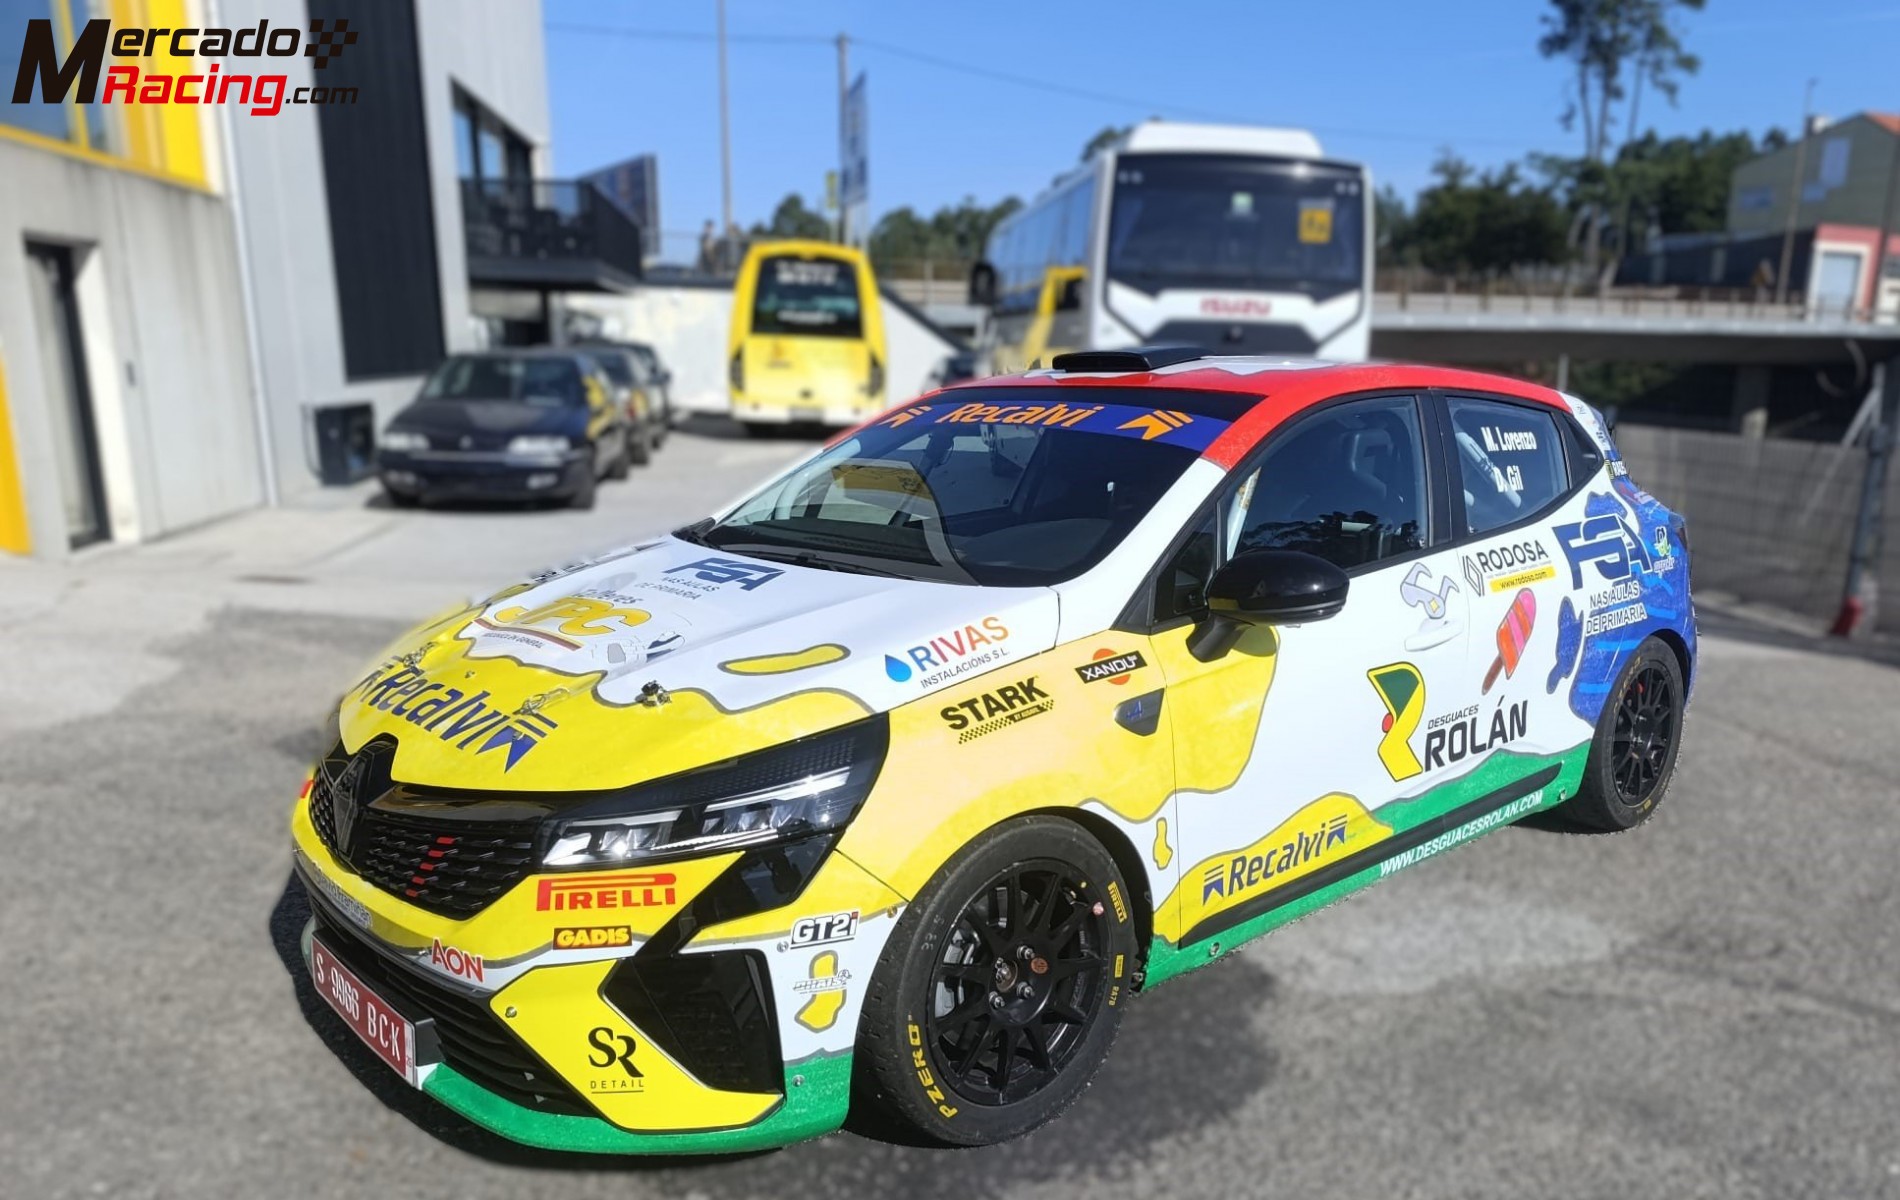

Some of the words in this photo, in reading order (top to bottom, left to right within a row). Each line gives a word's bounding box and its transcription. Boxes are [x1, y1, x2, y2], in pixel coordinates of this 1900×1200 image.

[935, 403, 1104, 427] Recalvi
[1481, 426, 1499, 451] M.
[1495, 426, 1537, 451] Lorenzo
[1493, 466, 1508, 493] D.
[1506, 465, 1524, 491] Gil
[1476, 540, 1549, 573] RODOSA
[1499, 570, 1548, 589] www.rodosa.com
[1589, 590, 1608, 609] NAS
[1608, 581, 1639, 603] AULAS
[1586, 617, 1599, 634] DE
[1601, 604, 1647, 630] PRIMARIA
[907, 616, 1009, 672] RIVAS
[368, 666, 510, 750] Recalvi
[940, 676, 1049, 730] STARK
[1428, 704, 1479, 730] DESGUACES
[1424, 695, 1528, 771] ROLÁN
[1380, 790, 1543, 877] WWW.DESGUACESROLAN.COM
[1228, 823, 1327, 895] Recalvi
[536, 873, 677, 911] PIRELLI
[556, 927, 629, 947] GADIS
[792, 911, 859, 944] GT2i
[432, 938, 484, 982] AON
[316, 953, 324, 984] S
[331, 967, 359, 1020] 9966
[367, 1002, 400, 1061] BCK
[588, 1027, 644, 1078] SR
[590, 1079, 644, 1089] DETAIL
